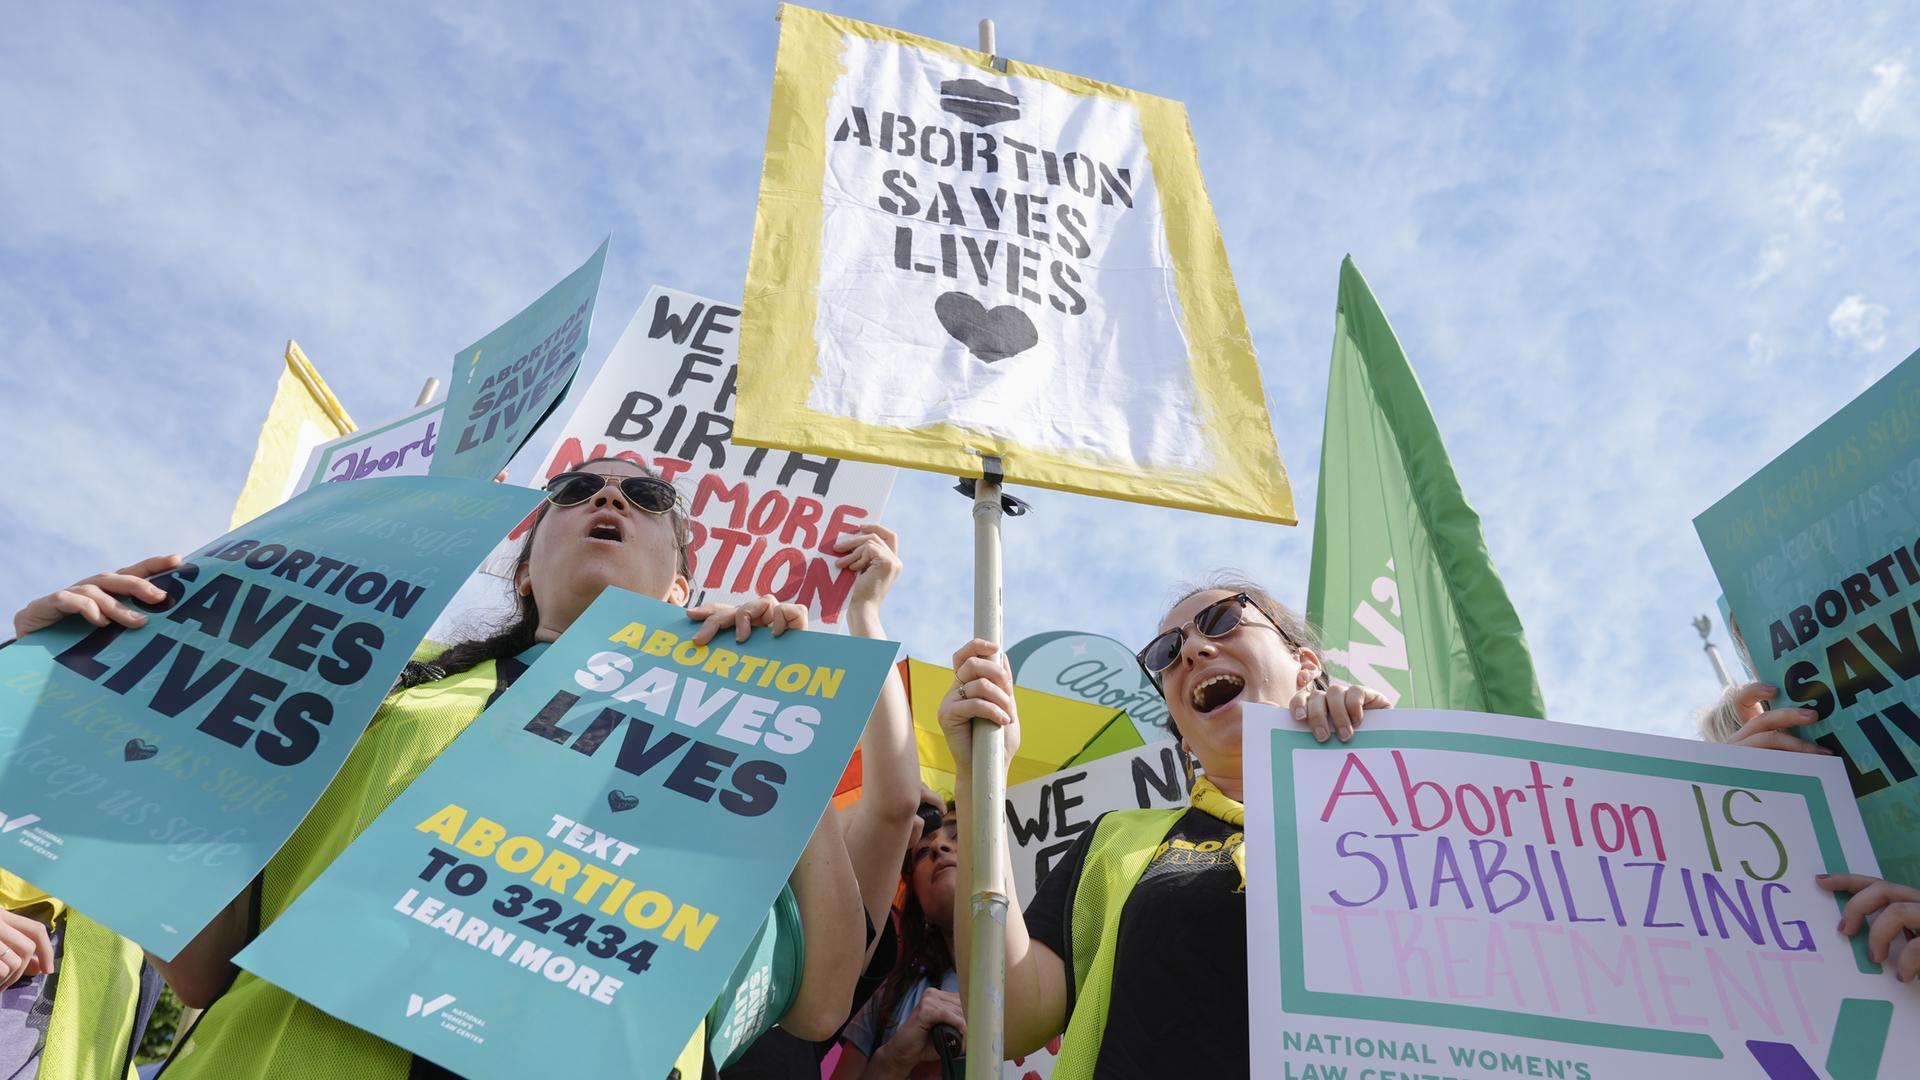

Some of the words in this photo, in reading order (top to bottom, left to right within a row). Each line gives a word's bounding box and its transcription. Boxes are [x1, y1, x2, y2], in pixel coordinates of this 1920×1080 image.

[833, 106, 1133, 208] ABORTION
[878, 169, 1091, 259] SAVES
[894, 226, 1087, 315] LIVES
[468, 320, 583, 421] SAVES
[478, 297, 590, 395] ABORTION
[648, 295, 741, 355] WE
[455, 352, 576, 455] LIVES
[690, 473, 868, 557] MORE
[138, 563, 385, 686] SAVES
[1769, 537, 1920, 662] ABORTI
[53, 624, 334, 766] LIVES
[574, 651, 822, 755] SAVES
[608, 622, 846, 699] ABORTION
[1784, 600, 1920, 722] SAV
[523, 689, 787, 817] LIVES
[546, 814, 640, 866] TEXT
[1006, 772, 1091, 847] WE
[1320, 750, 1667, 861] Abortion
[1692, 784, 1788, 881] IS
[415, 803, 720, 952] ABORTION
[418, 847, 488, 896] TO
[492, 884, 659, 975] 32434
[1329, 831, 1817, 952] STABILIZING
[393, 888, 517, 957] LEARN
[508, 940, 624, 1005] MORE
[1311, 904, 1825, 1044] TREATMENT
[1282, 1031, 1437, 1064] NATIONAL
[1448, 1046, 1591, 1080] WOMEN'S
[1283, 1061, 1349, 1080] LAW
